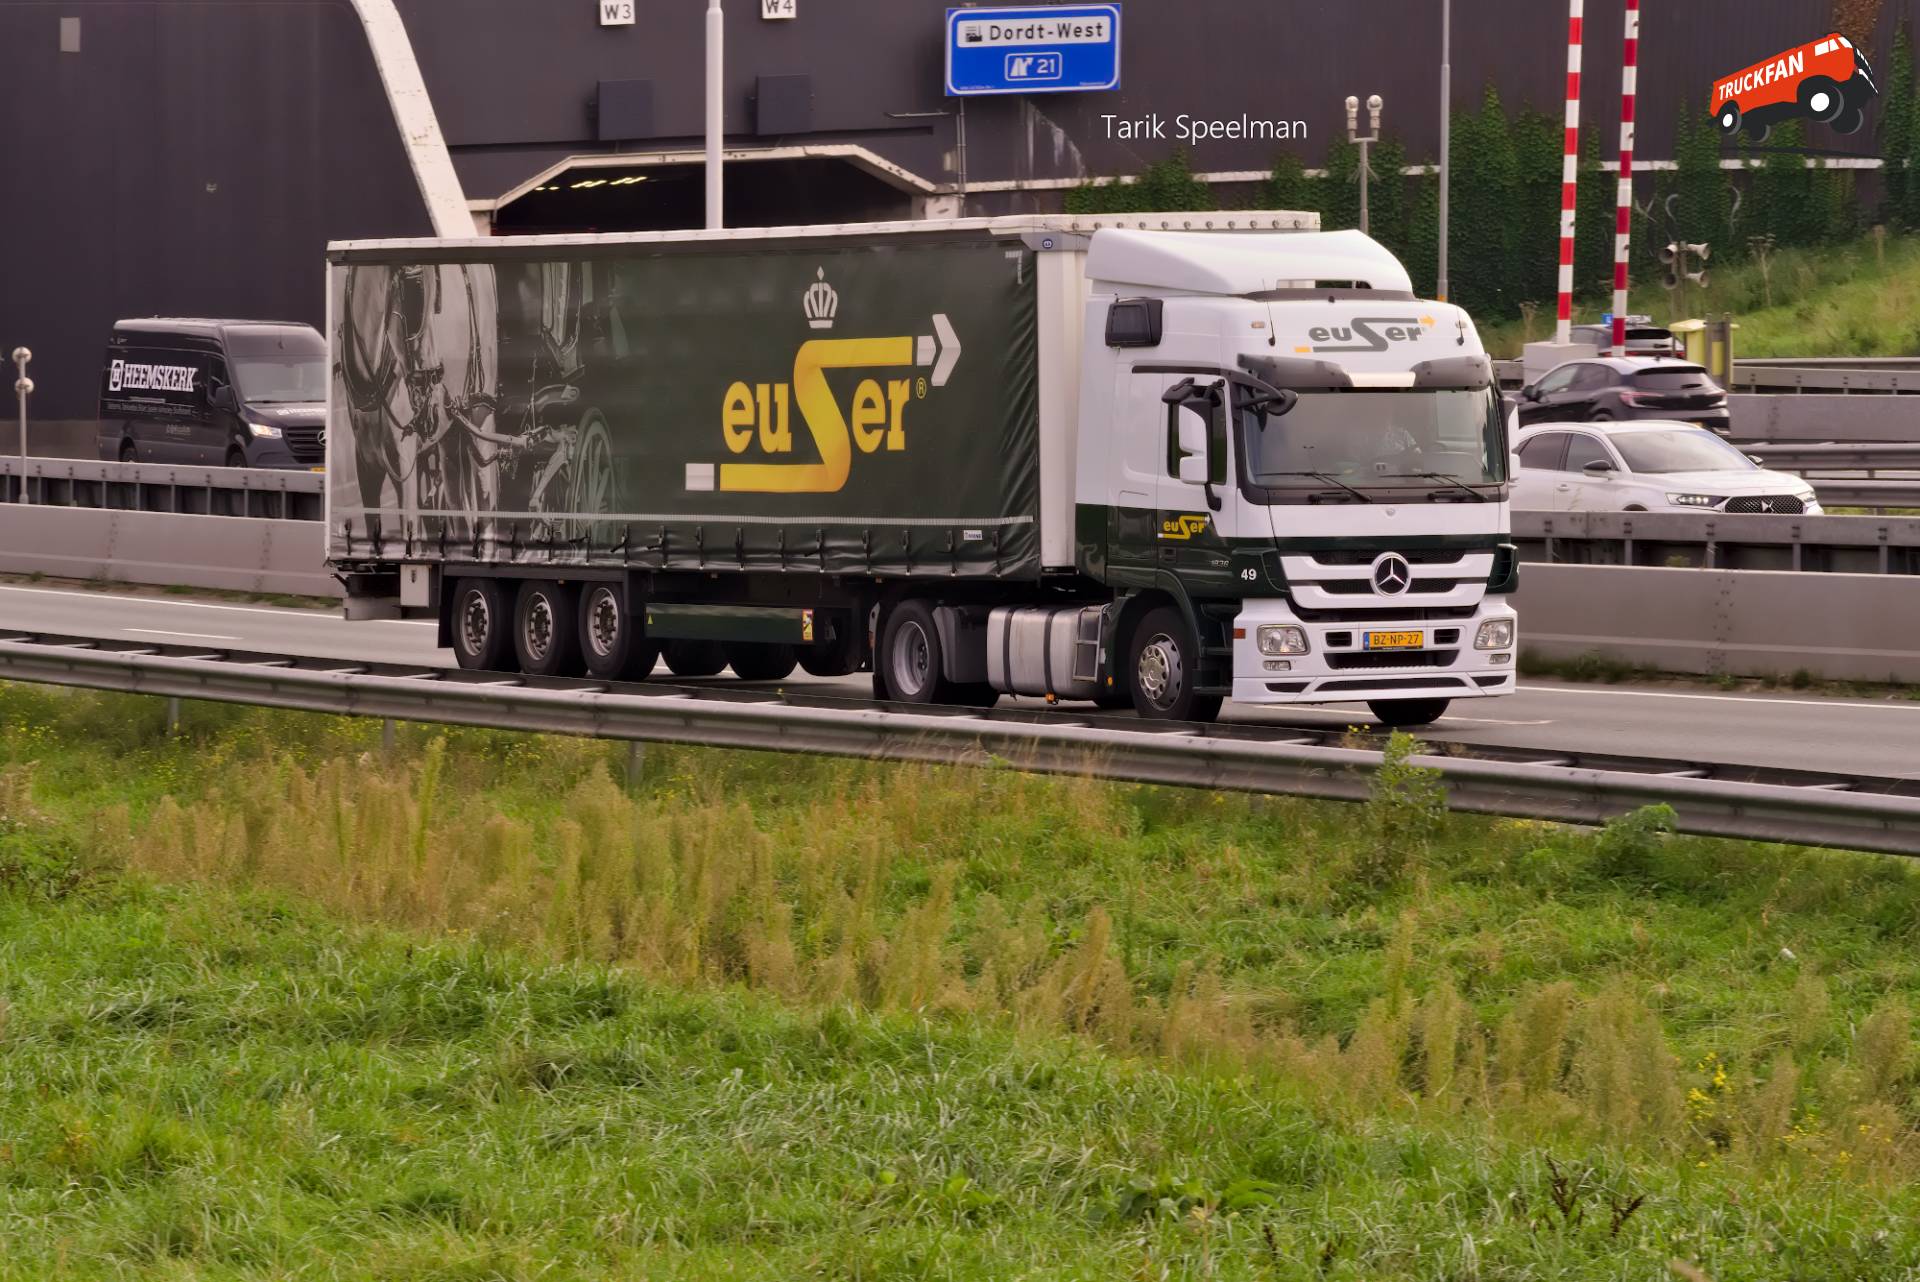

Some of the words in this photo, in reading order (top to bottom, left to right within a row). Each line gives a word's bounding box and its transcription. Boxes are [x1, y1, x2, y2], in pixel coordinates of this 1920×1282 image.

[989, 23, 1104, 41] Dordt-West
[1036, 58, 1056, 75] 21
[122, 363, 199, 393] HEEMSKERK
[1240, 568, 1258, 581] 49
